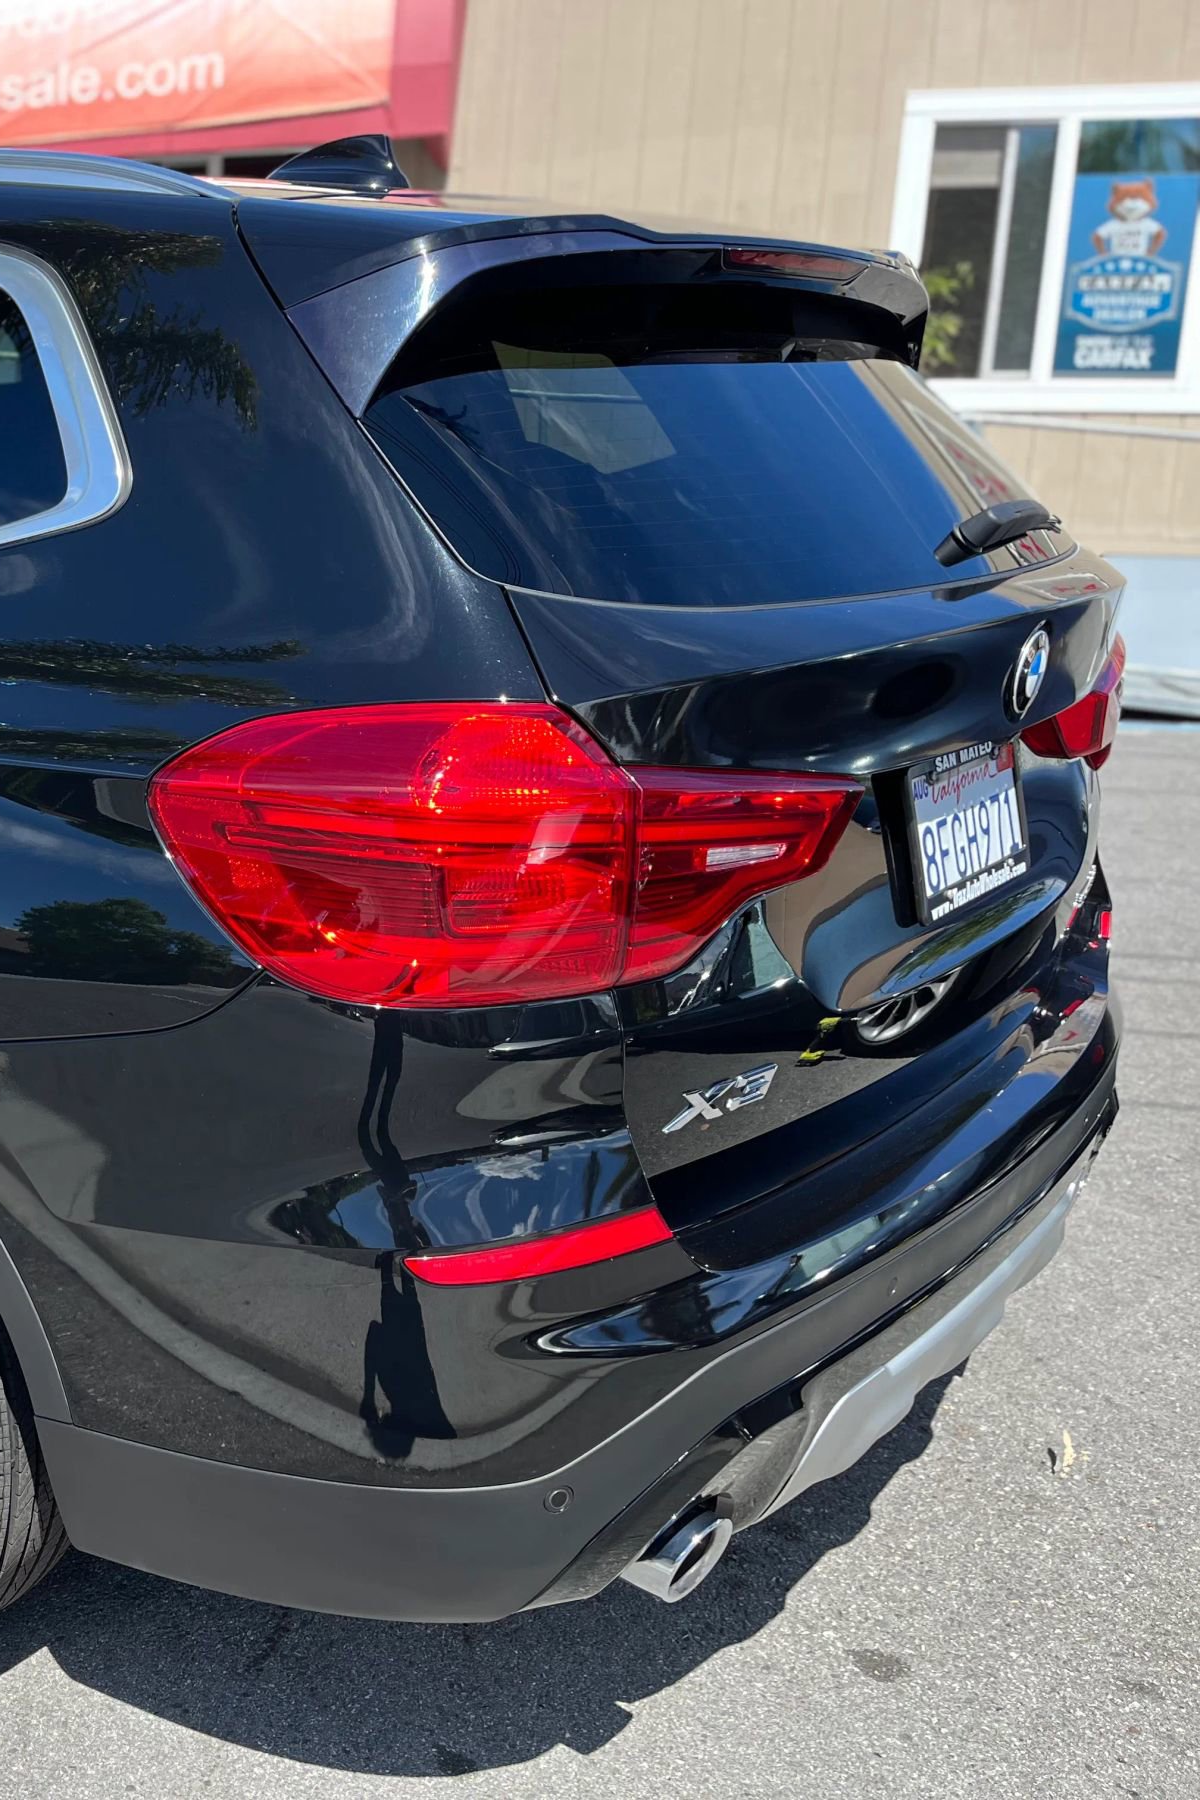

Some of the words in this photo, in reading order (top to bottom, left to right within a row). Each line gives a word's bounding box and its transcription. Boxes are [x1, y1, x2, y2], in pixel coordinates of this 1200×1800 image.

[935, 752, 957, 773] SAN
[960, 740, 993, 763] MATEO
[913, 775, 929, 802] AUG
[931, 762, 998, 806] California
[921, 788, 1020, 894] 8FGH971
[662, 1062, 779, 1135] X3
